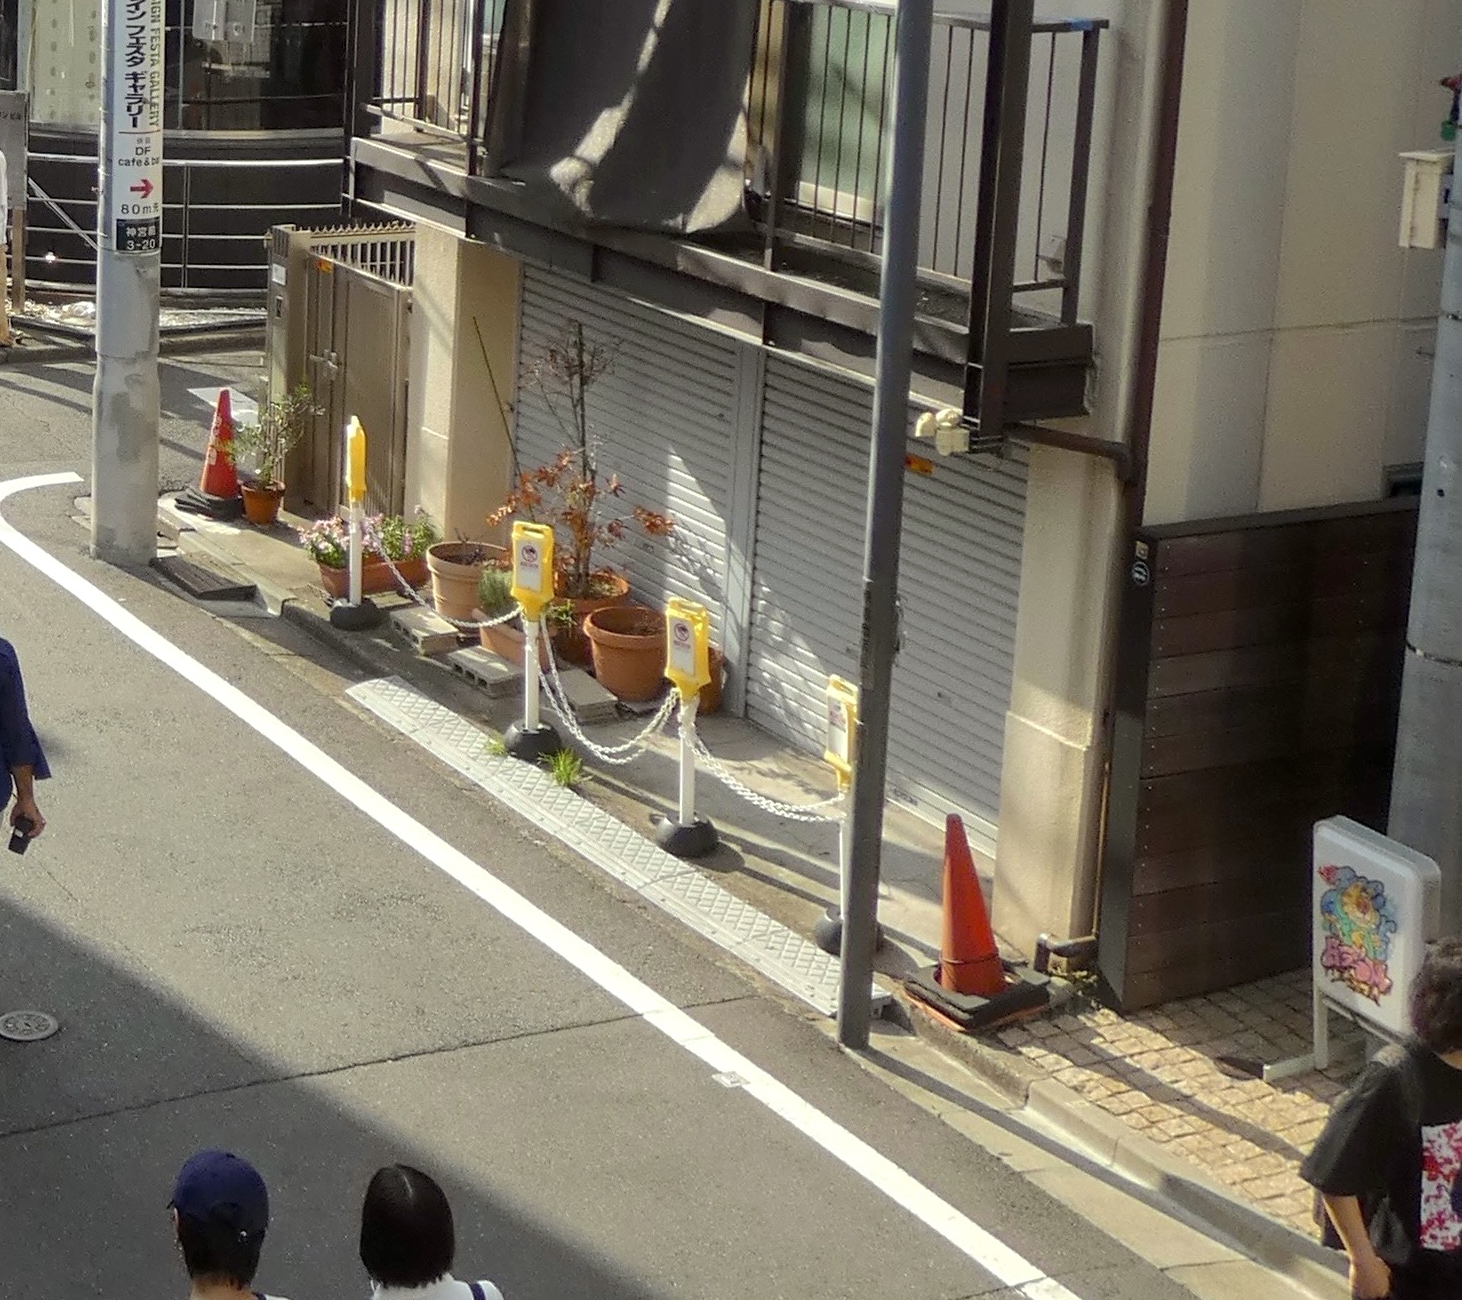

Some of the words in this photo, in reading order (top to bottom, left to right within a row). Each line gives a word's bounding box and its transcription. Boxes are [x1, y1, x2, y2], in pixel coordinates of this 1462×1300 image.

[150, 28, 161, 68] FESTA
[149, 71, 160, 127] GALLERY
[135, 146, 151, 156] DF
[118, 158, 142, 167] cafe
[126, 239, 156, 250] 3-20
